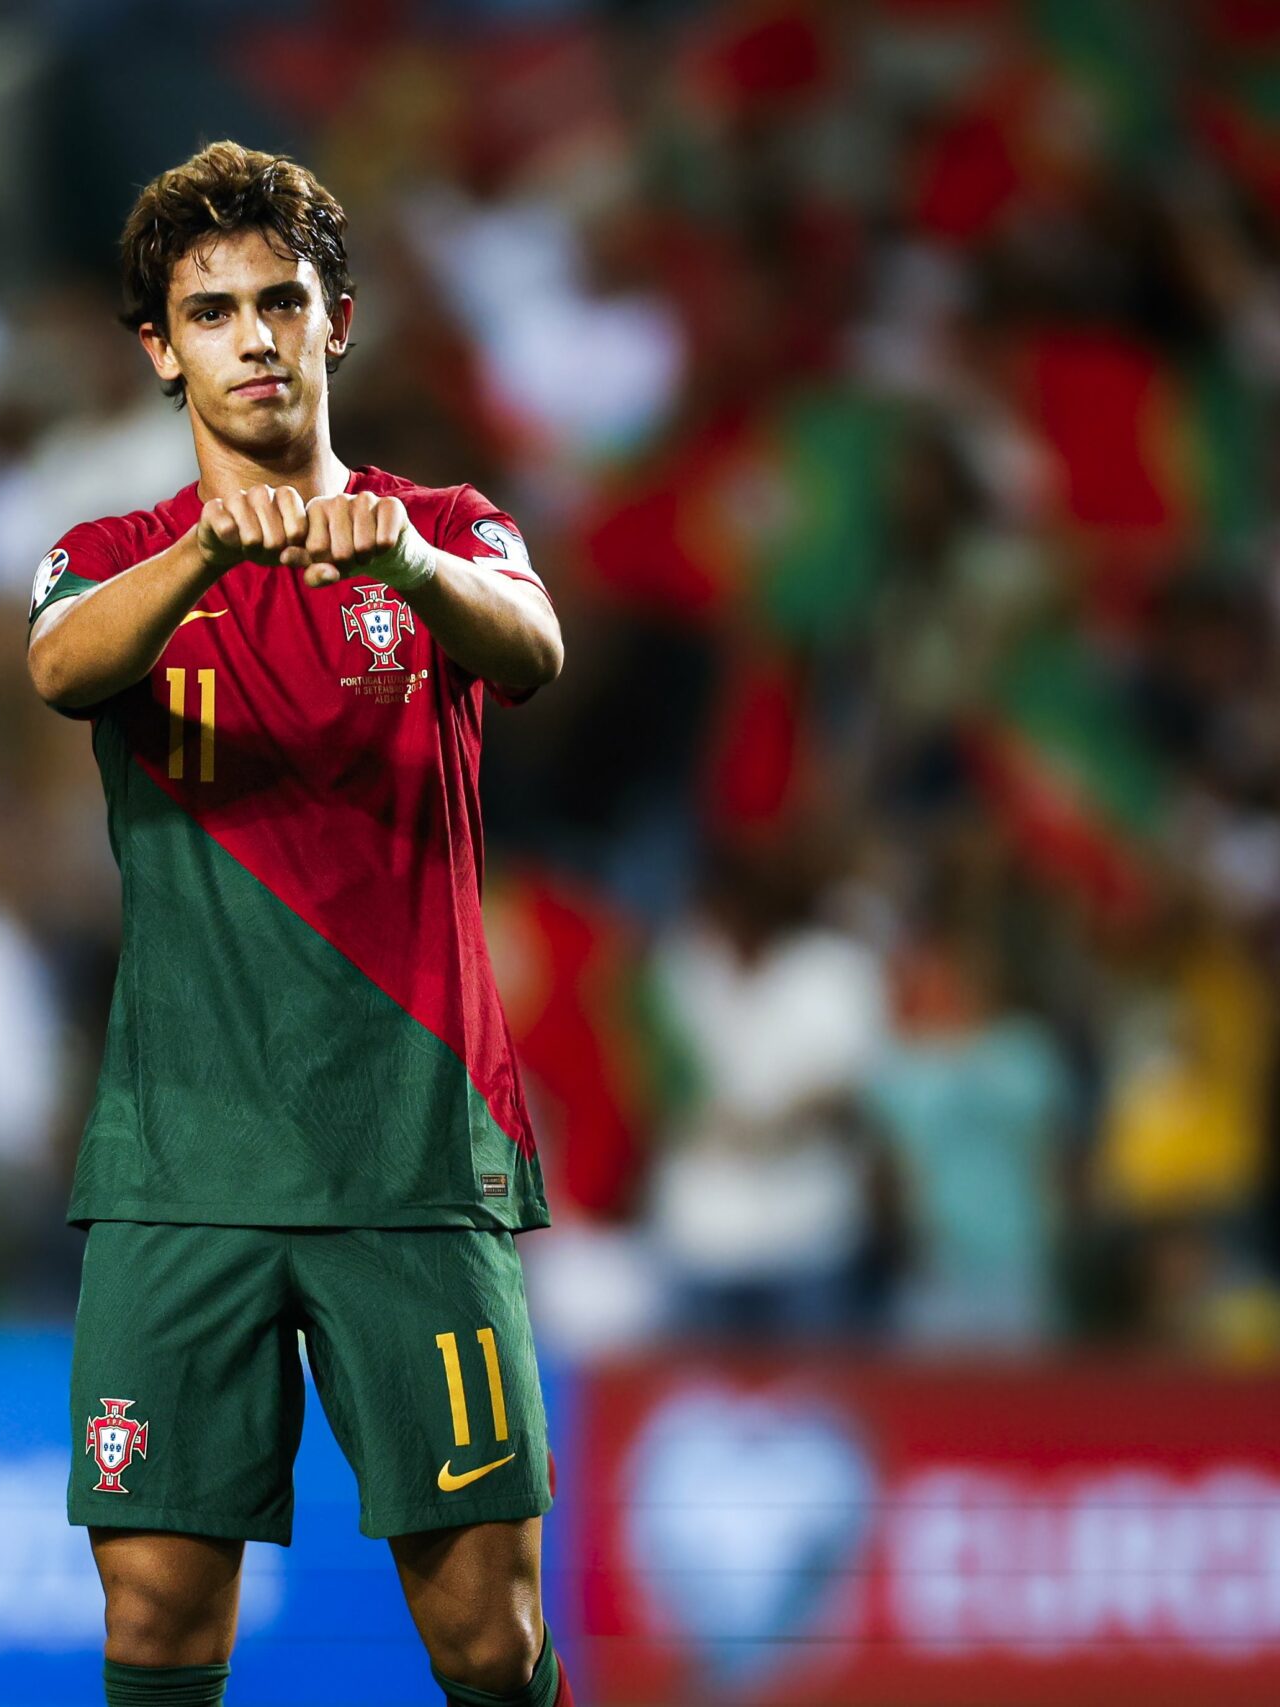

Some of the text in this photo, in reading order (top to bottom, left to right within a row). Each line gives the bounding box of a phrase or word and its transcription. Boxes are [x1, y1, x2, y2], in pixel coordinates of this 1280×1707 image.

[374, 693, 411, 705] ALGARE
[406, 680, 423, 695] 203
[166, 667, 215, 782] 11
[435, 1327, 508, 1446] 11
